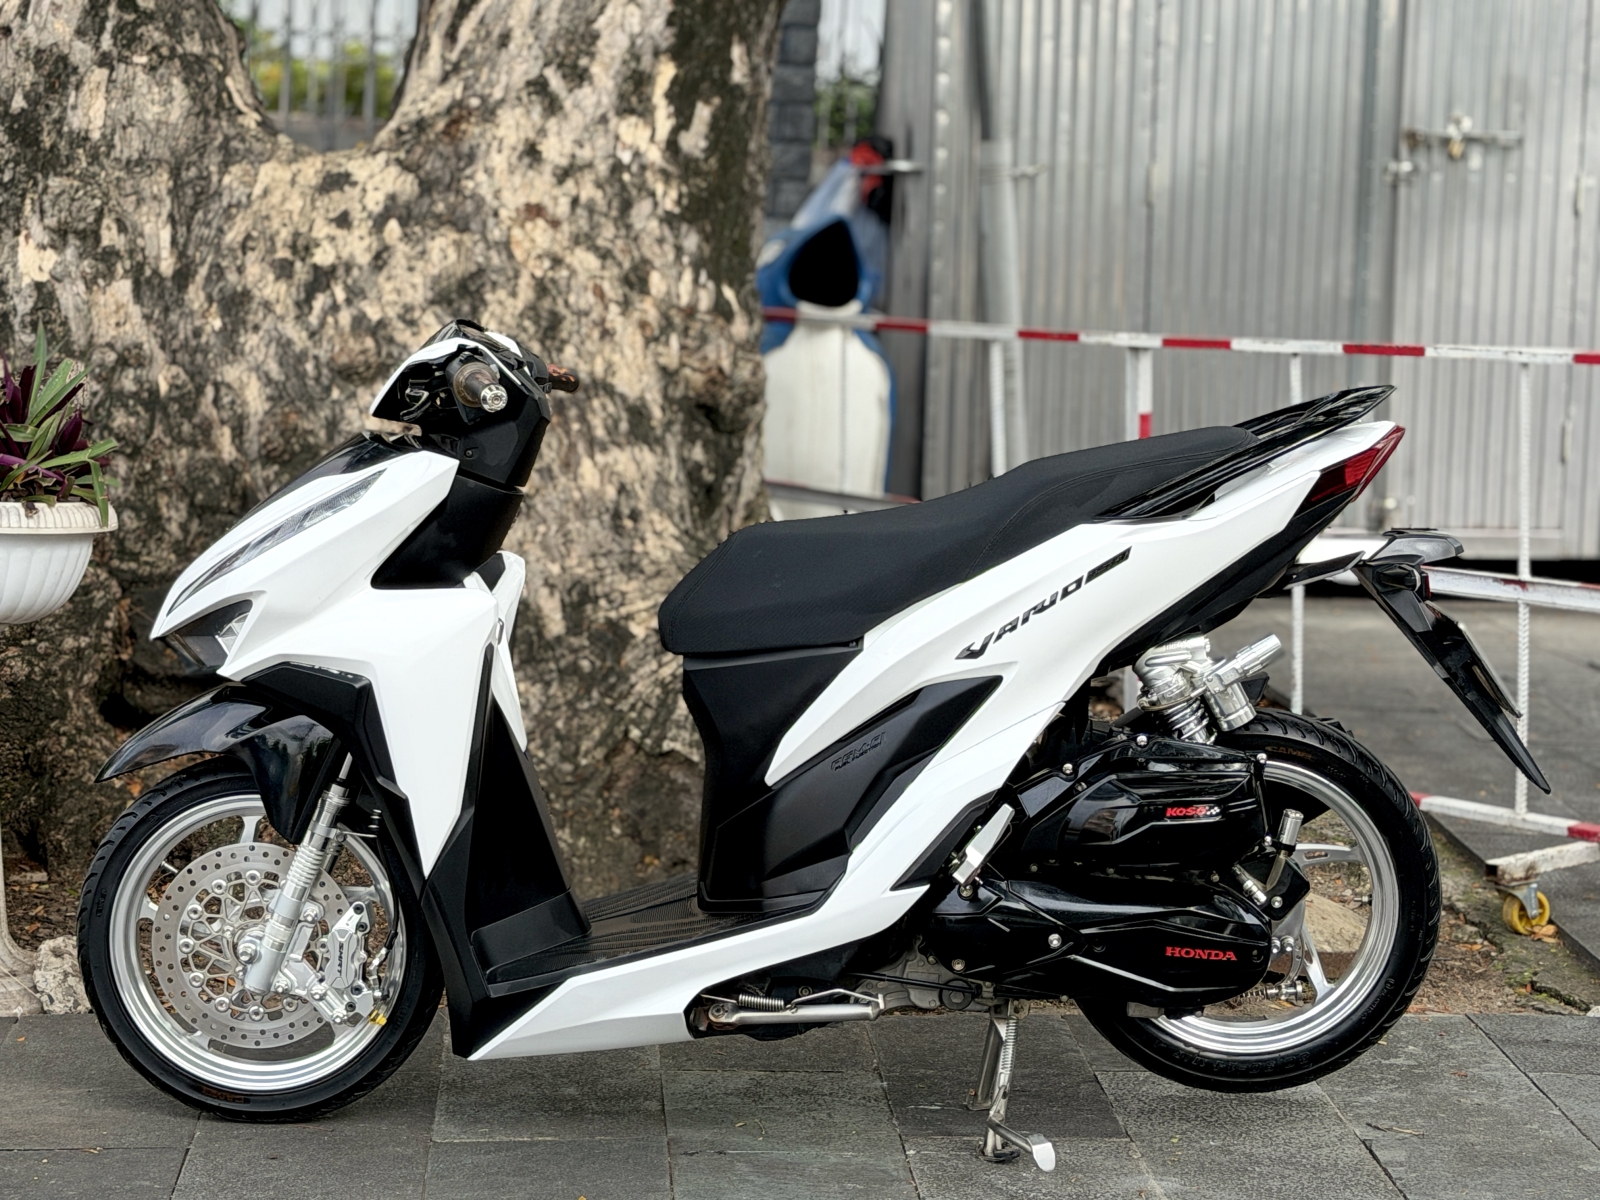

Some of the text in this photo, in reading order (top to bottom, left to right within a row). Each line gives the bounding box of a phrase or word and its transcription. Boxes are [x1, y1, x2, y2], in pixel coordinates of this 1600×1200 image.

[954, 575, 1085, 660] VARIO
[1165, 805, 1208, 818] KOSO
[1165, 946, 1237, 961] HONDA
